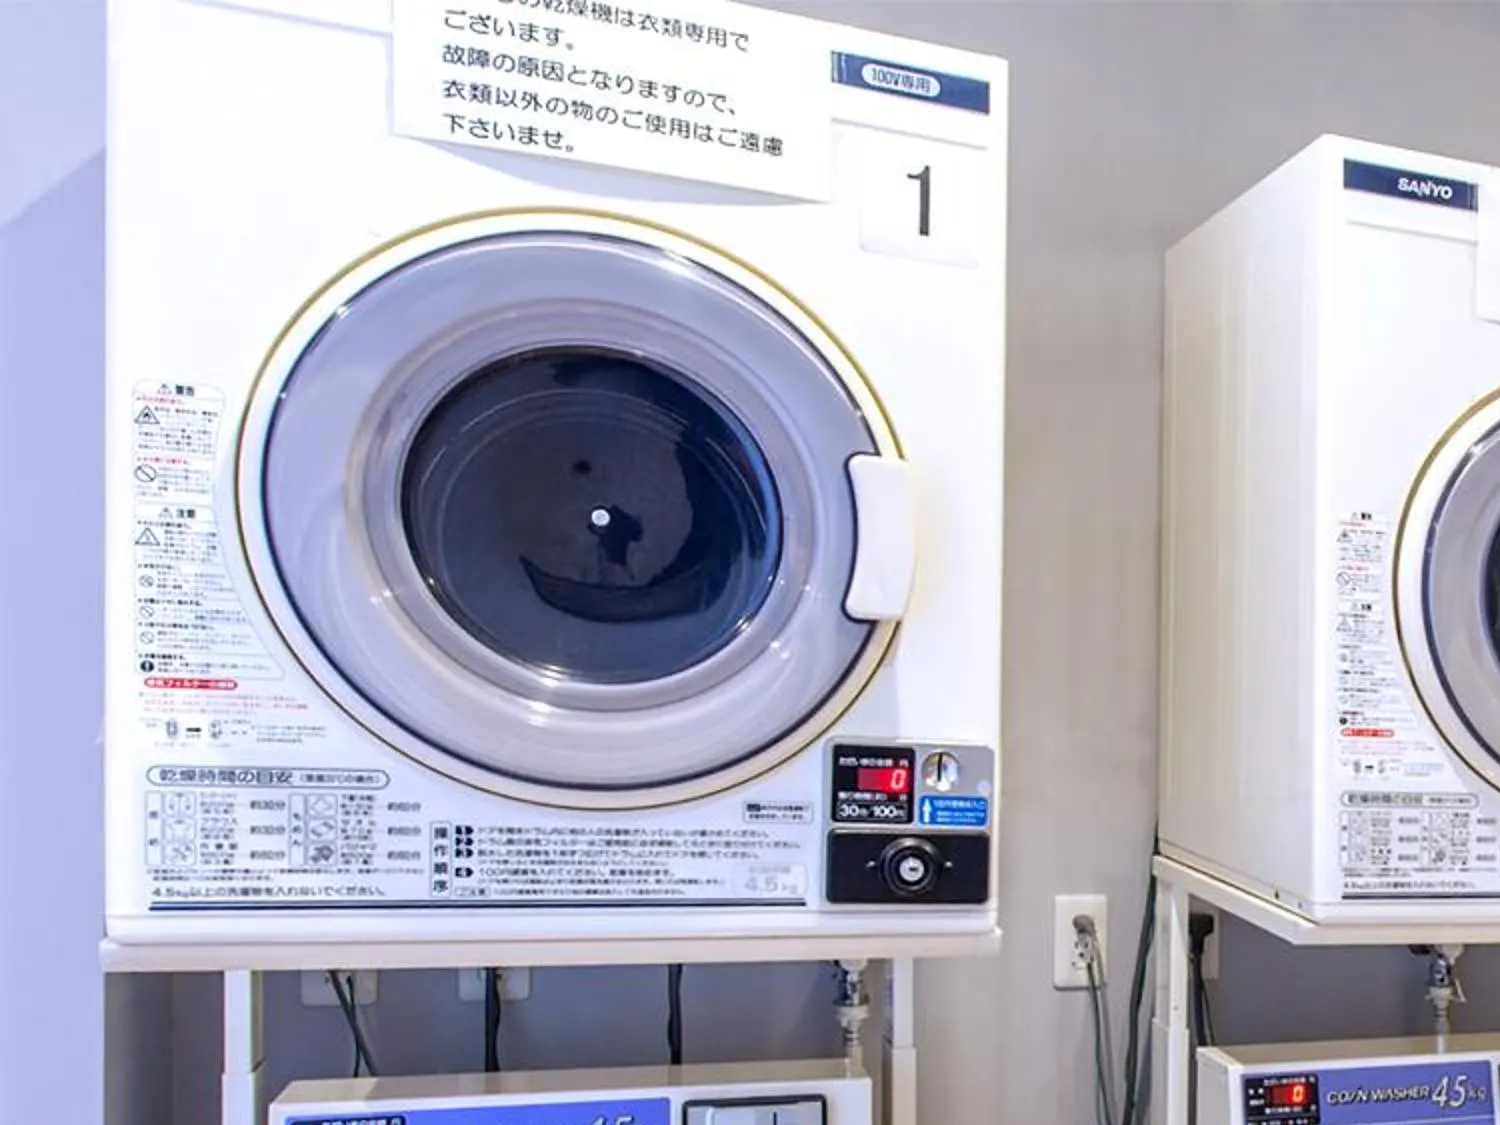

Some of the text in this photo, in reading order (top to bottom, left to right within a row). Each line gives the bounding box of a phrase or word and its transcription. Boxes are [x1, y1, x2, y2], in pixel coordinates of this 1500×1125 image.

[444, 9, 575, 50] ございます。
[441, 43, 737, 116] 故障の原因となりますので、
[441, 79, 784, 158] 衣類以外の物のご使用はご遠慮
[441, 113, 575, 153] 下さいませ。
[906, 165, 931, 236] 1
[1397, 177, 1453, 199] SANYO
[890, 769, 907, 789] 0
[1292, 1085, 1305, 1103] 0
